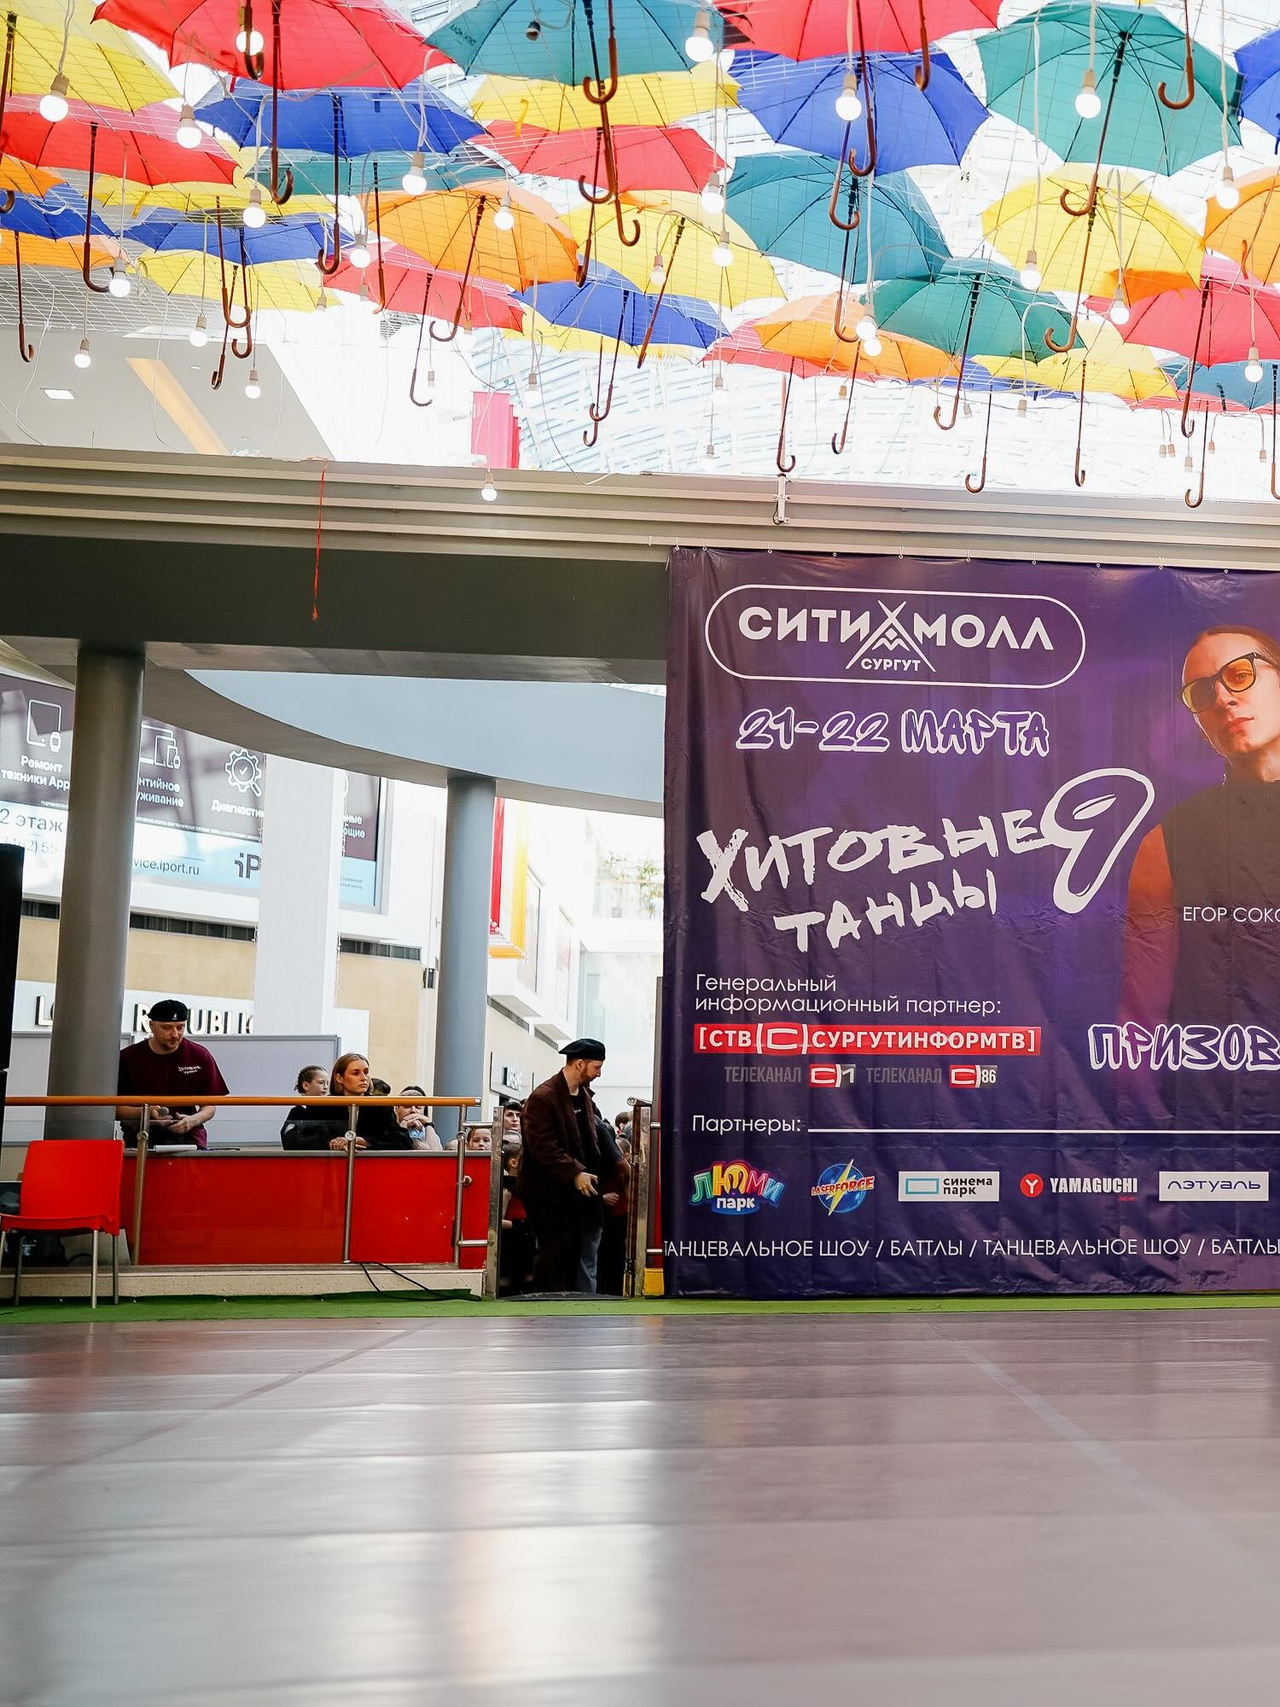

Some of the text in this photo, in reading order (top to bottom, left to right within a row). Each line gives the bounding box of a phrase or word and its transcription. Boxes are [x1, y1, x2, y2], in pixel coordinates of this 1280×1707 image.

[738, 605, 1054, 651] СИТИ МОЛЛ
[861, 657, 921, 672] СУРГУТ
[736, 706, 1050, 757] 21-22 МАРТА
[21, 754, 63, 773] Ремонт
[1, 769, 71, 792] техники App
[138, 777, 181, 793] нтийное
[15, 815, 63, 832] этаж
[133, 858, 200, 876] vice.iport.ru
[696, 809, 1048, 912] ХИТОВЫЕ
[773, 867, 998, 952] ТАНЦЫ
[1183, 906, 1228, 922] ЕГОР
[696, 973, 837, 994] Генеральный
[695, 995, 1002, 1016] информационный партнер:
[724, 1065, 802, 1084] ТЕЛЕКАНАЛ
[866, 1066, 942, 1084] ТЕЛЕКАНАЛ
[692, 1114, 802, 1133] Партнеры:
[943, 1176, 993, 1187] синема
[1050, 1177, 1138, 1194] YAMAGUCHI
[943, 1185, 976, 1198] парк
[716, 1197, 756, 1212] парк
[819, 1239, 870, 1257] ШОУ
[890, 1239, 962, 1257] БАТТЛЫ
[983, 1239, 1137, 1259] ТАНЦЕВАЛЬНОЕ
[1144, 1238, 1191, 1256] ШОУ
[1211, 1238, 1280, 1256] БАТТЛЫ
